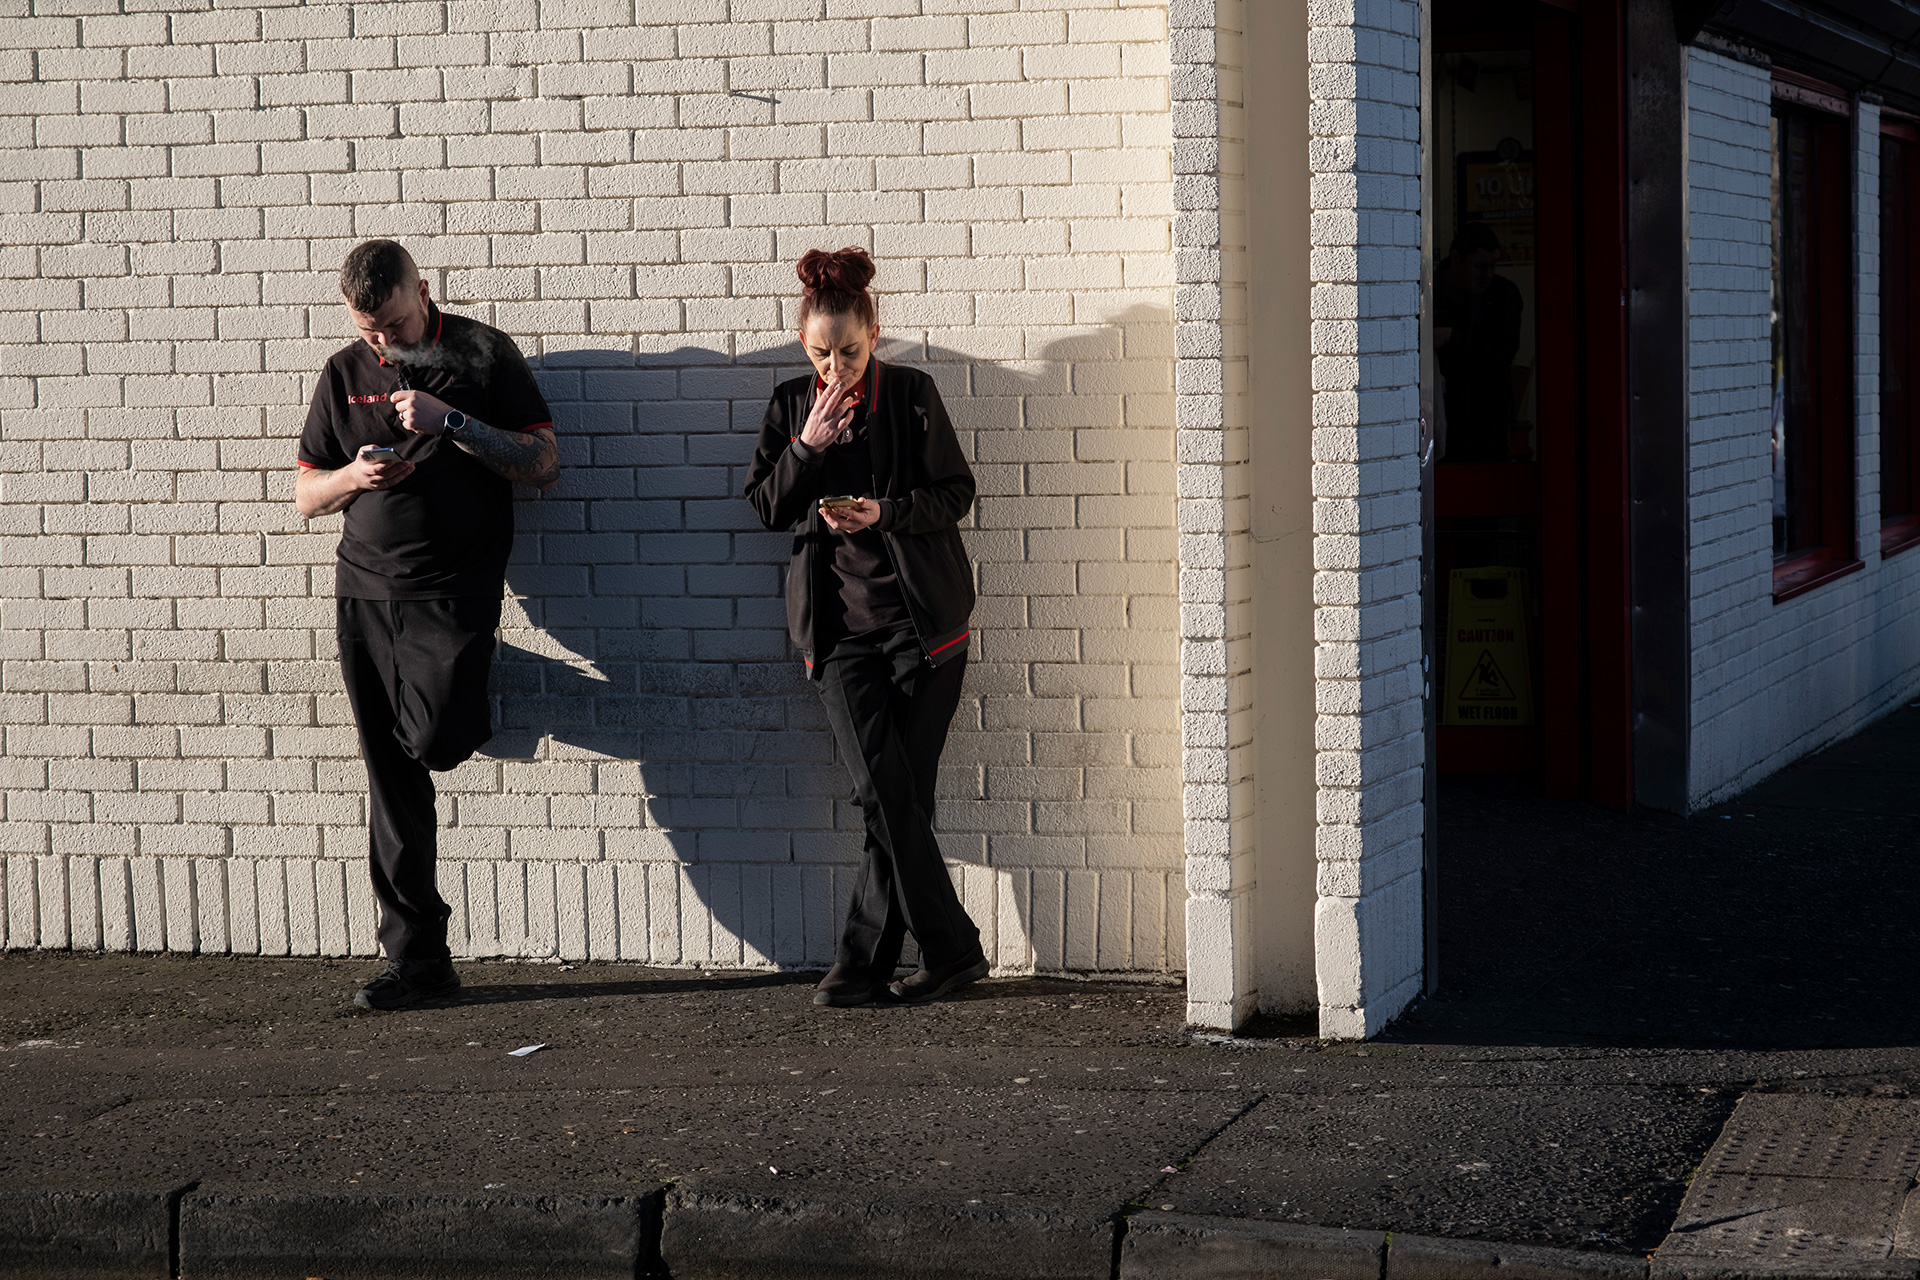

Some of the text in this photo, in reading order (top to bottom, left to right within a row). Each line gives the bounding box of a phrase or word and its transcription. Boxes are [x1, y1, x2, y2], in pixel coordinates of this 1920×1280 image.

[1476, 177, 1502, 195] 10
[347, 392, 387, 405] Iceland
[1457, 629, 1514, 642] CAUTION
[1458, 705, 1518, 719] WET FLOOR
